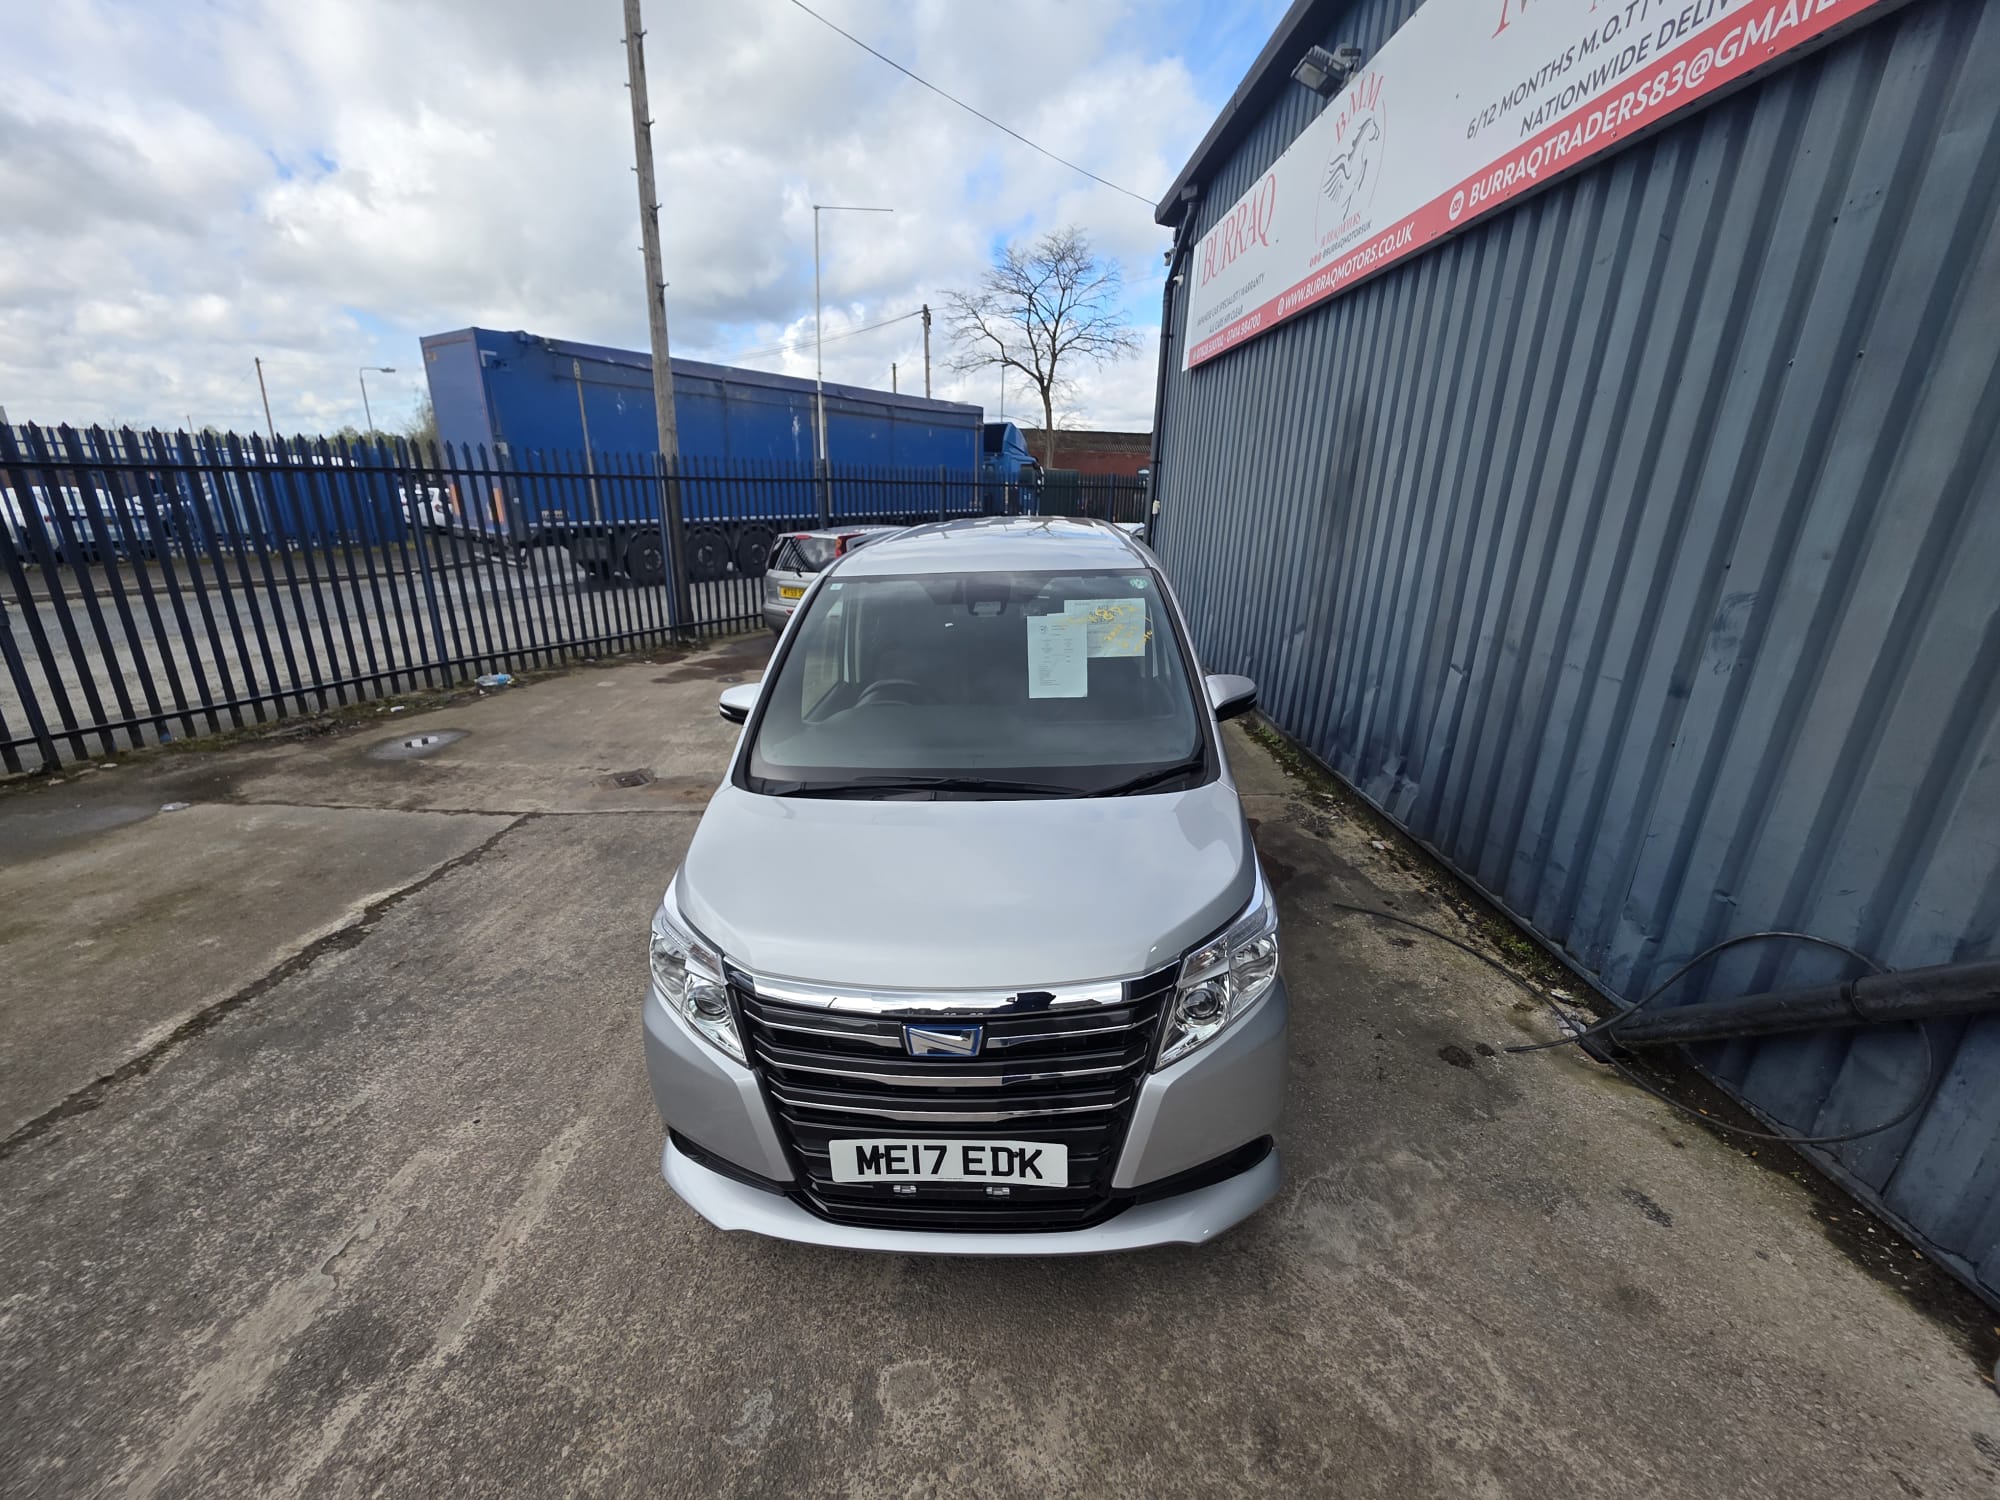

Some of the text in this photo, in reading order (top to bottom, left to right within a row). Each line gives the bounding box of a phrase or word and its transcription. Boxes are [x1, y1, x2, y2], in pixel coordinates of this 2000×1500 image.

[1466, 103, 1498, 140] 6/12
[1499, 45, 1576, 118] MONTHS
[1519, 32, 1653, 137] NATIONWIDE
[1655, 0, 1729, 51] DELI
[1201, 173, 1276, 288] BURRAQ
[1284, 222, 1414, 310] WWW.BURRAQMOTORS.CO.UK
[855, 1144, 1044, 1180] ME17 EDK
